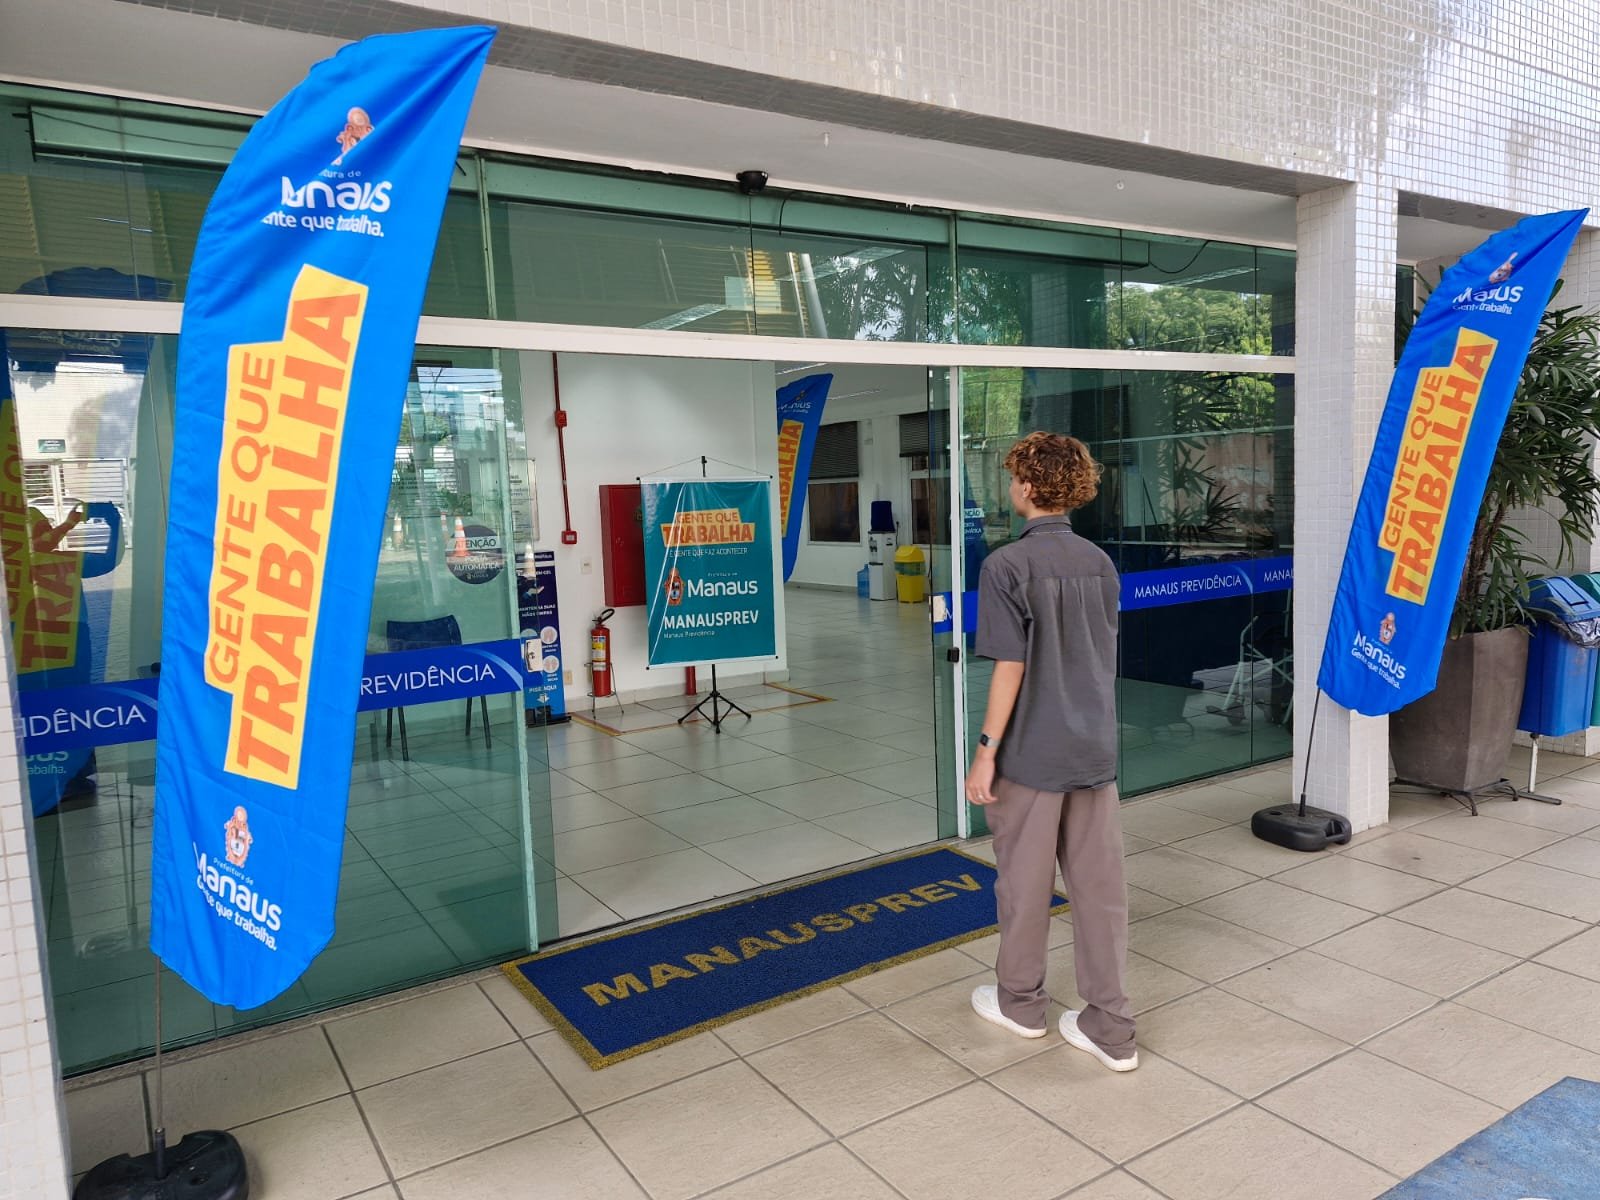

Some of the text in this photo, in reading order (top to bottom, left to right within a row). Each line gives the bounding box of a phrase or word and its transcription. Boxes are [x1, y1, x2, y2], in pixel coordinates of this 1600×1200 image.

[301, 215, 335, 232] que
[1383, 371, 1444, 548] GENTE QUE
[1392, 343, 1494, 598] TRABALHA
[209, 351, 276, 685] GENTE QUE
[237, 293, 361, 775] TRABALHA
[662, 523, 754, 545] TRABALHA
[675, 511, 739, 524] GENTE QUE
[687, 579, 759, 598] Manaus
[1134, 574, 1242, 600] MANAUS PREVIDÊNCIA
[664, 610, 759, 631] MANAUSPREV
[1353, 629, 1407, 680] Manaus
[215, 901, 234, 921] que
[234, 911, 278, 952] trabalha.
[581, 873, 983, 1006] MANAUSPREV
